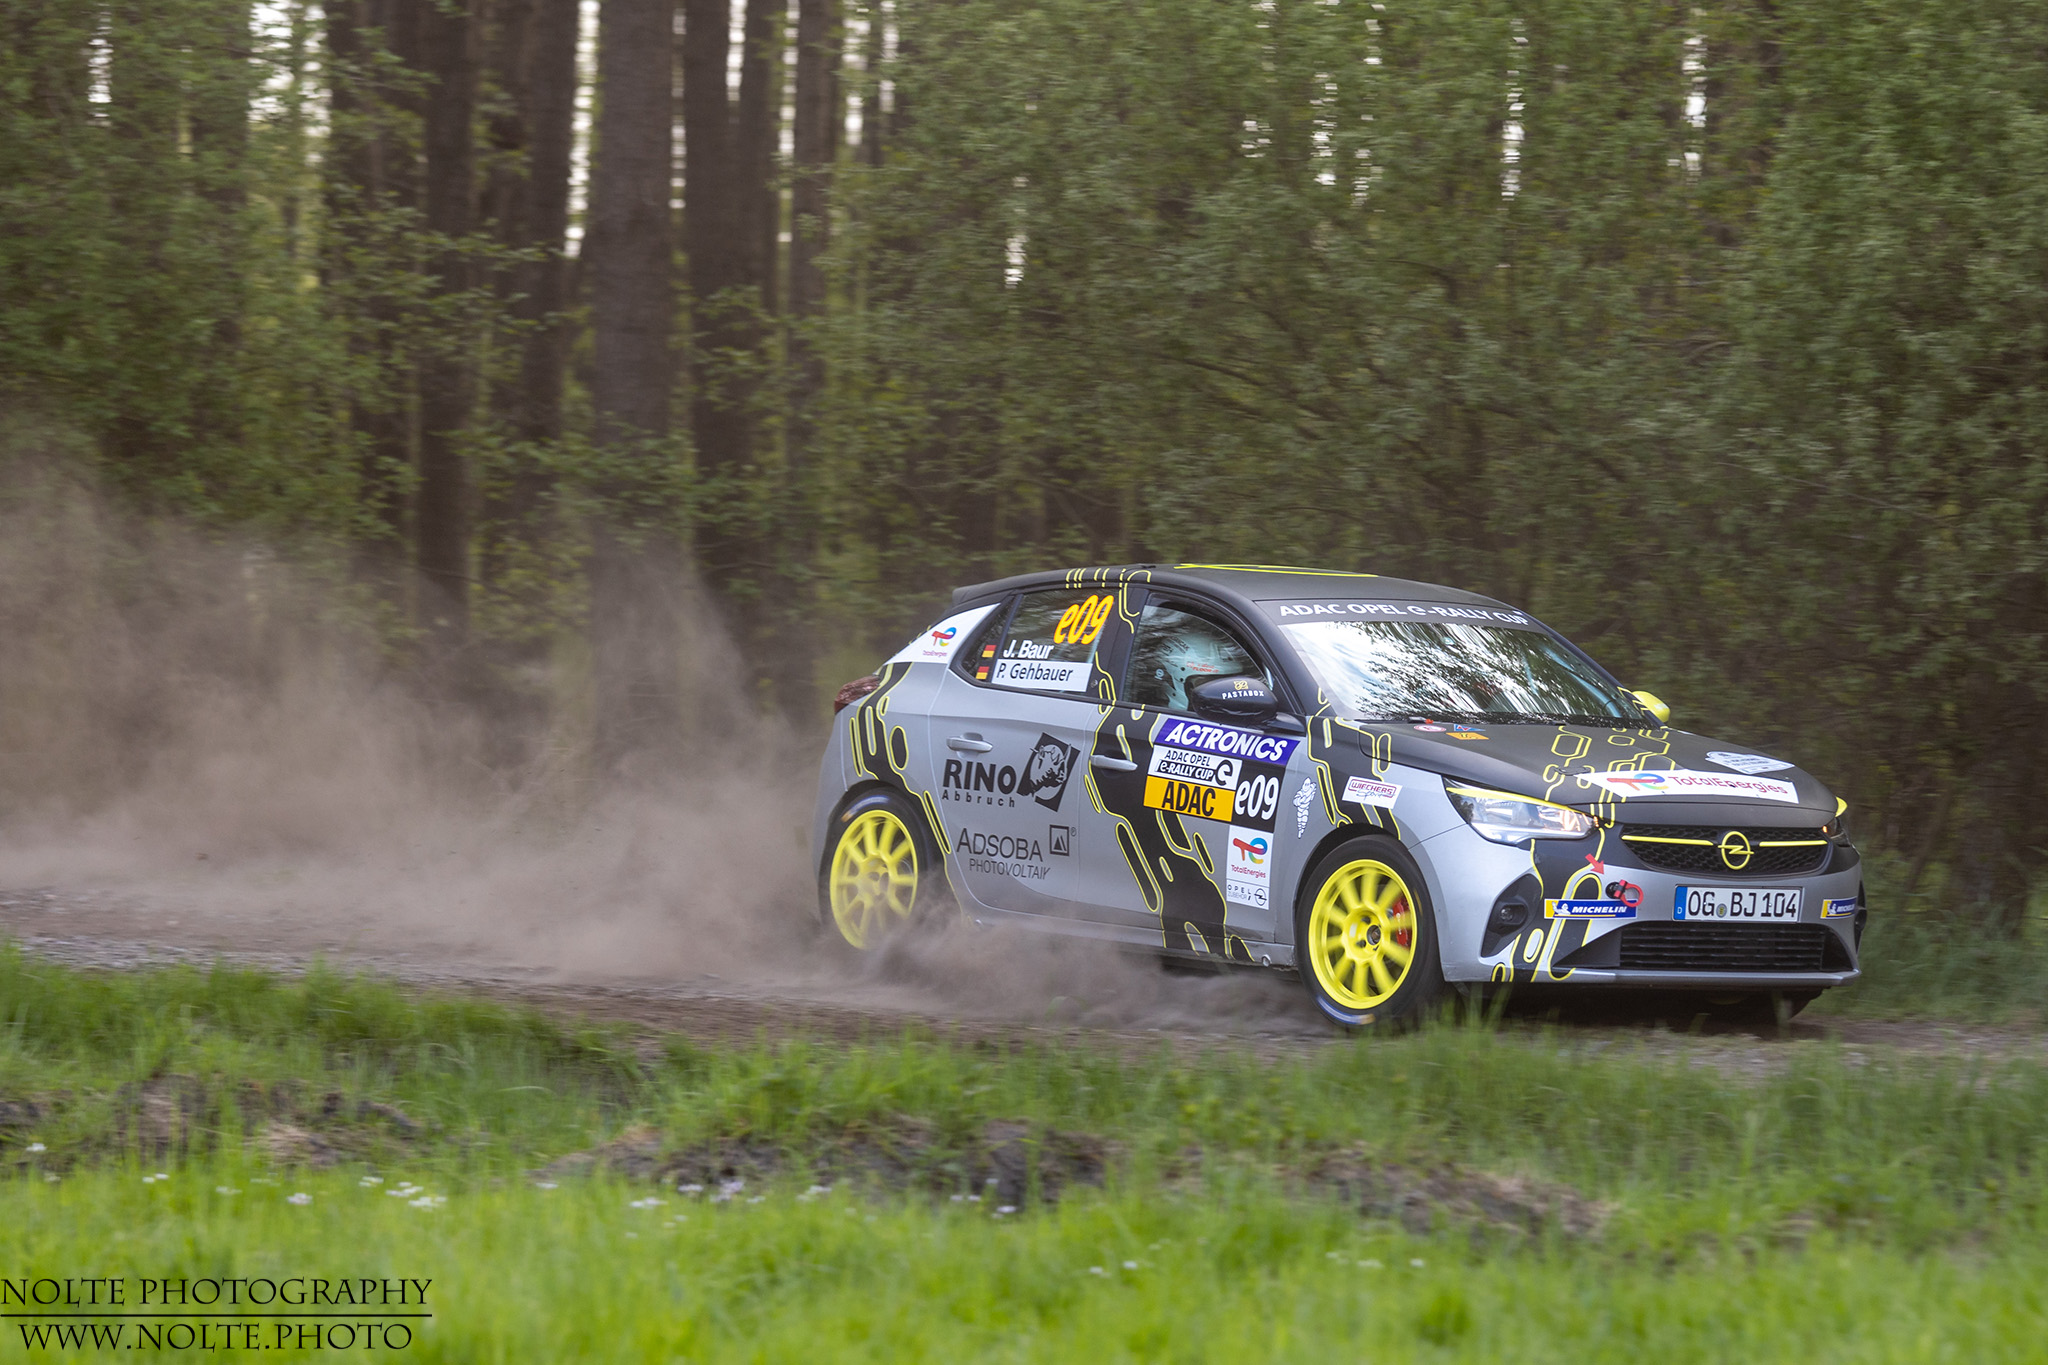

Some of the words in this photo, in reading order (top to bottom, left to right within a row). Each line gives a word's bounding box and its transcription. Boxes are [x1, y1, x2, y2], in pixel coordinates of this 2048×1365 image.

[1053, 595, 1114, 644] e09
[1280, 604, 1346, 617] ADAC
[1347, 603, 1408, 616] OPEL
[1407, 605, 1494, 621] e-RALLY
[1493, 610, 1529, 626] CUP
[1003, 640, 1015, 658] J.
[1018, 640, 1054, 660] Baur
[996, 665, 1005, 679] P.
[1010, 663, 1073, 681] Gehbauer
[1222, 690, 1264, 699] PASTABOX
[1165, 722, 1288, 761] ACTRONICS
[1164, 750, 1189, 763] ADAC
[1190, 754, 1210, 766] OPEL
[943, 759, 1016, 794] RINO
[1159, 761, 1194, 776] e-RALLY
[1195, 767, 1214, 780] CUP
[1351, 782, 1393, 795] WIECHERS
[1668, 776, 1788, 794] TotalEnergies
[942, 790, 1015, 807] Abbruch
[1162, 781, 1216, 816] ADAC
[1234, 774, 1279, 820] e09
[956, 828, 1043, 862] ADSOBA
[969, 858, 1051, 880] PHOTOVOLTAIK
[1231, 865, 1266, 878] TotalEnergies
[1228, 884, 1251, 894] OPEL
[1571, 905, 1627, 914] MICHELIN
[1688, 890, 1715, 917] OG
[1730, 891, 1757, 917] BJ
[1760, 892, 1797, 918] 104
